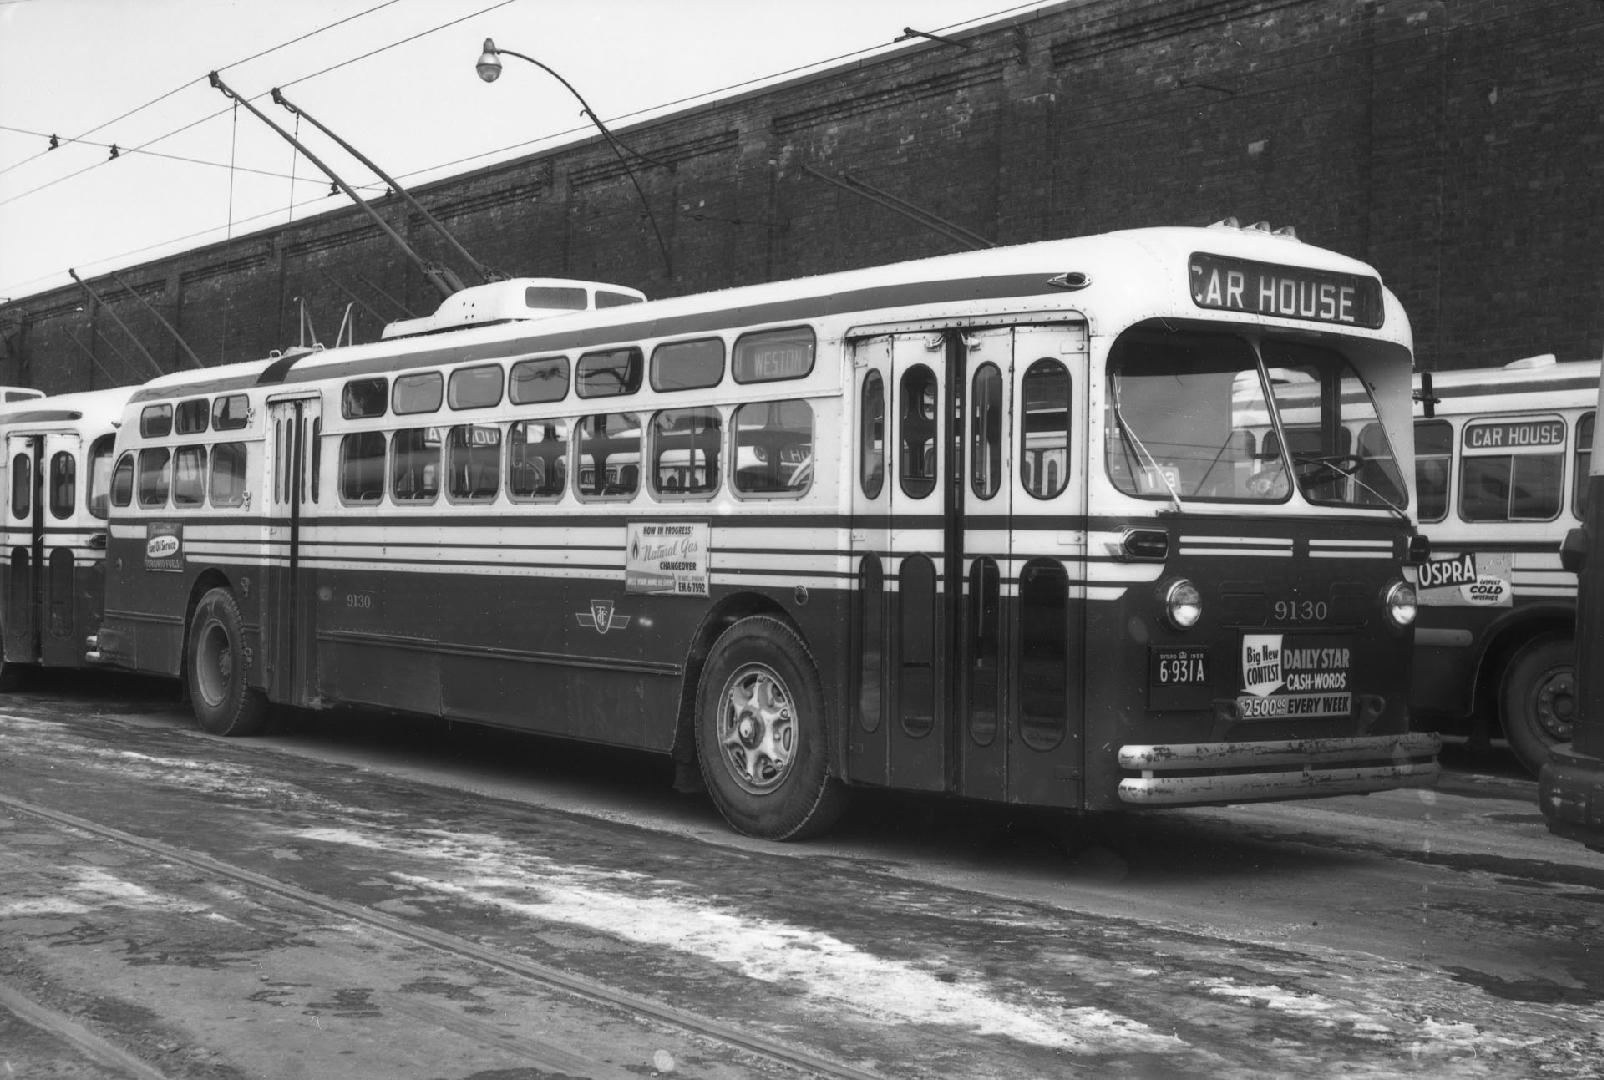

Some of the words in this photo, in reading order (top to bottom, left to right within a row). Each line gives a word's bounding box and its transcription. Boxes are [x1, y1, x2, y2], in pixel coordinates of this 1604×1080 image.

[1259, 275, 1355, 322] HOUSE
[1472, 427, 1503, 447] CAR
[1508, 424, 1562, 444] HOUSE
[643, 526, 656, 535] NOW
[657, 526, 664, 535] IN
[641, 541, 678, 561] Natural
[681, 537, 698, 559] Gas
[660, 561, 697, 571] CHANGEOVER
[1470, 585, 1504, 595] COLD
[346, 594, 371, 608] 9130
[1274, 601, 1328, 620] 9130
[1246, 646, 1261, 665] Big
[1262, 645, 1279, 662] New
[1284, 649, 1321, 669] DAILY
[1321, 648, 1350, 668] STAR
[1246, 664, 1279, 687] CONTEST
[1286, 672, 1347, 690] CASH-WORDS
[1288, 697, 1320, 714] EVERY
[1322, 696, 1350, 713] WEEK
